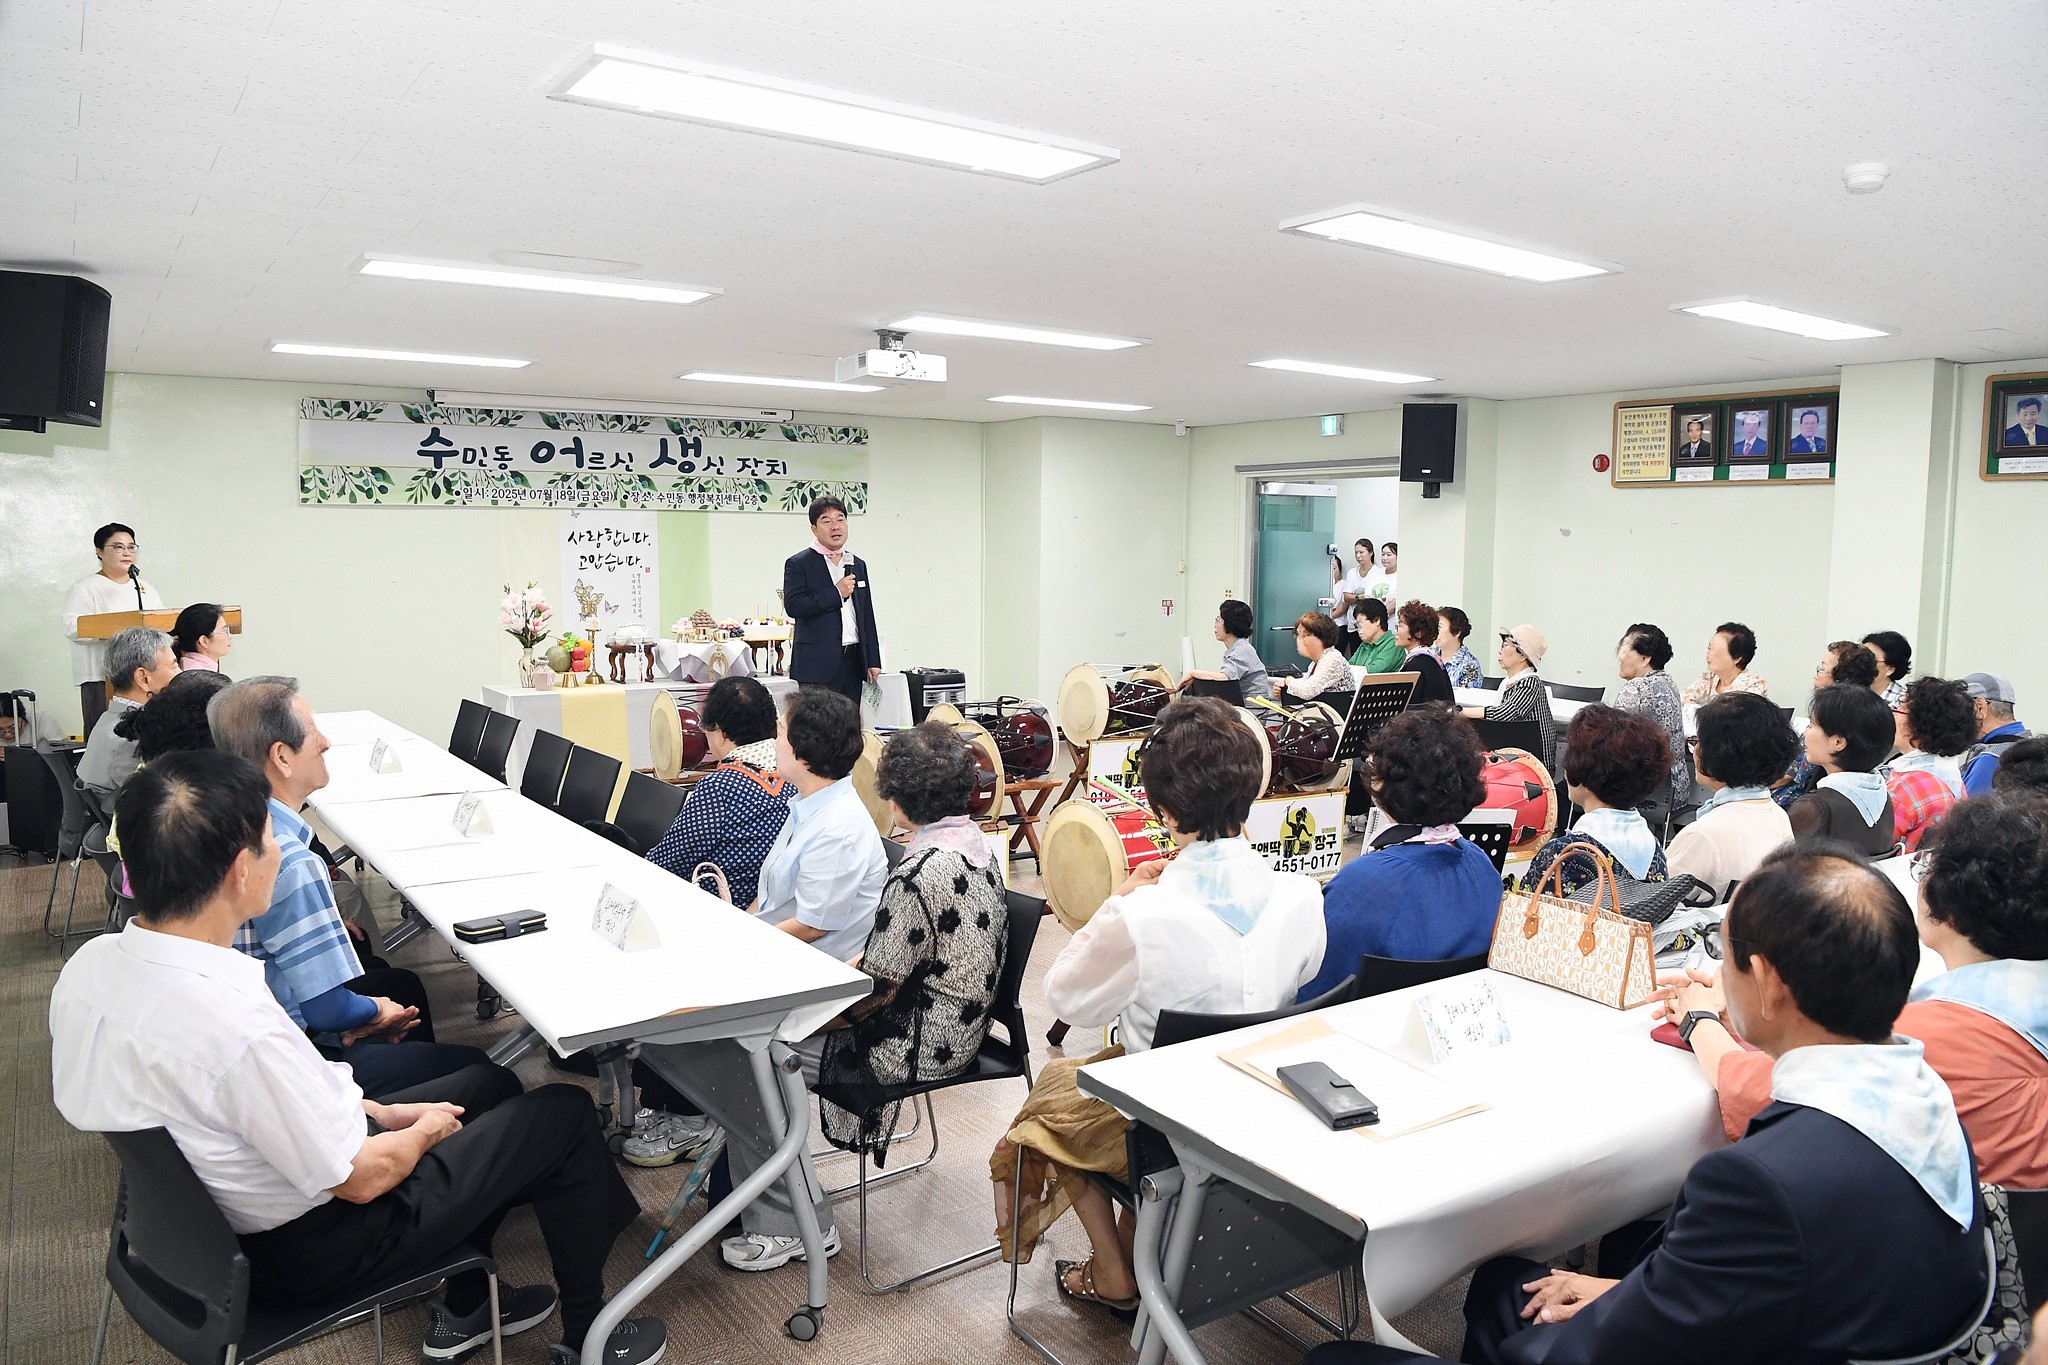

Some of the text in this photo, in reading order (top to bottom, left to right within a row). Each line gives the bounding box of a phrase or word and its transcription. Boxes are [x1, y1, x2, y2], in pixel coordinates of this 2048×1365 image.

[417, 427, 787, 476] 수민동 어르신 생신 잔치
[463, 488, 615, 501] 일시: 2025년 07월 18일(금요일)
[631, 491, 759, 505] 장소: 수민동 행정복지센터 2층
[567, 528, 651, 548] 사랑합니다.
[578, 552, 643, 572] 고맙습니다.
